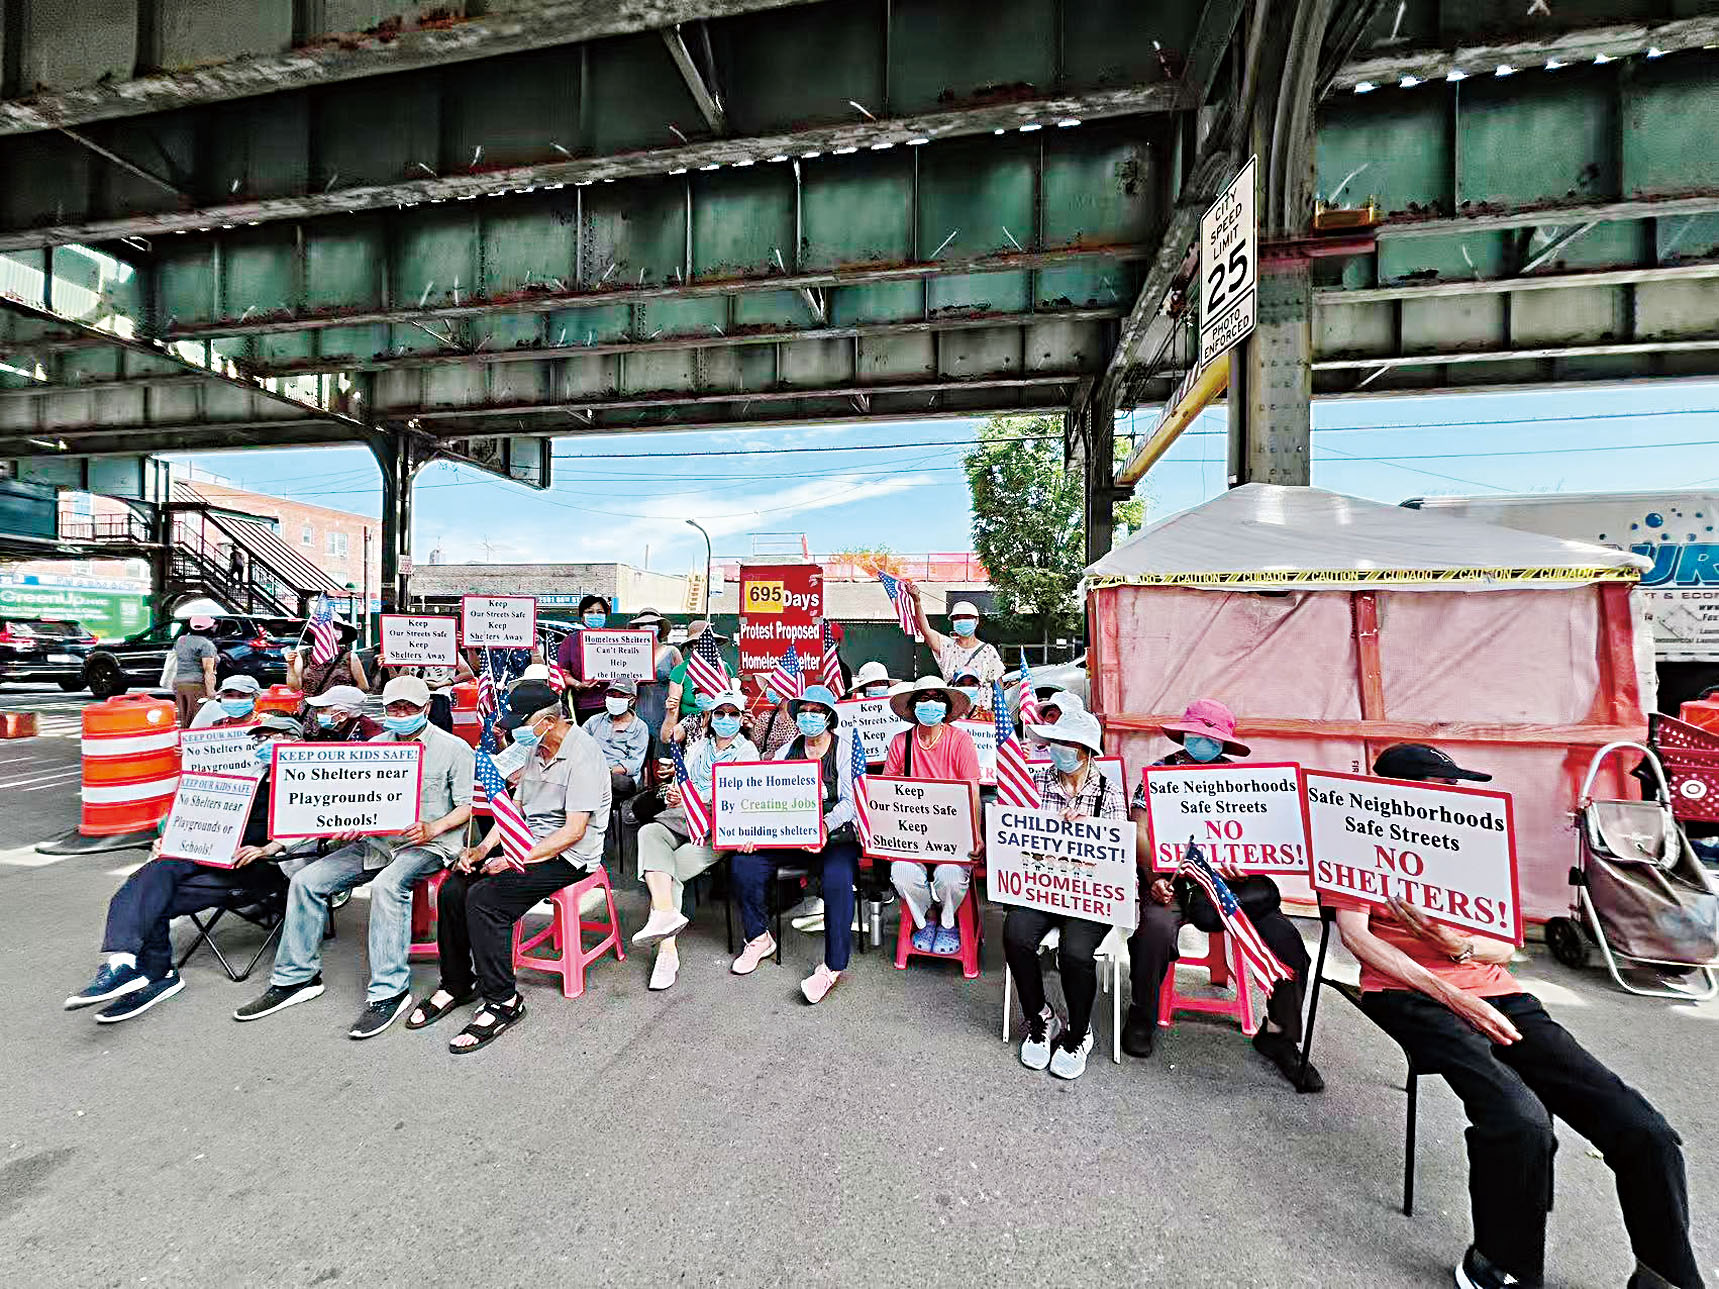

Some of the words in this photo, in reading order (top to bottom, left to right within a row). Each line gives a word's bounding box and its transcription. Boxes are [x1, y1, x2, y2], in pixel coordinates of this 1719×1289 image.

[1215, 188, 1237, 221] CITY
[1210, 203, 1242, 245] SPEED
[1213, 224, 1239, 261] LIMIT
[1207, 238, 1248, 314] 25
[1213, 309, 1240, 340] PHOTO
[1205, 315, 1249, 359] ENFORCED
[1178, 574, 1219, 583] CAUTION
[1312, 571, 1358, 580] CAUTION
[1384, 571, 1433, 580] CUIDADO
[488, 600, 508, 608] Keep
[750, 586, 781, 602] 695
[783, 590, 820, 611] Days
[408, 619, 428, 628] Keep
[488, 622, 507, 630] Keep
[585, 635, 619, 643] Homeless
[740, 622, 774, 639] Protest
[776, 621, 820, 644] Proposed
[409, 641, 429, 649] Keep
[618, 647, 640, 655] Really
[390, 651, 422, 660] Shelters
[426, 653, 446, 661] Away
[610, 659, 627, 667] Help
[861, 704, 882, 713] Keep
[859, 717, 887, 726] Streets
[182, 733, 204, 742] KEEP
[206, 732, 225, 740] OUR
[863, 731, 886, 741] Keep
[187, 747, 200, 756] No
[204, 744, 243, 755] Shelters
[278, 751, 314, 761] KEEP
[318, 751, 345, 760] OUR
[350, 751, 380, 760] KIDS
[383, 750, 418, 760] SAFE!
[191, 760, 251, 773] Playgrounds
[284, 769, 306, 781] No
[311, 768, 371, 780] Shelters
[377, 769, 408, 779] near
[199, 780, 214, 790] OUR
[215, 781, 231, 791] KIDS
[719, 777, 743, 790] Help
[746, 776, 763, 787] the
[766, 775, 816, 786] Homeless
[1149, 781, 1179, 794] Safe
[1184, 779, 1296, 796] Neighborhoods
[289, 791, 382, 806] Playgrounds
[387, 792, 402, 801] or
[894, 784, 924, 799] Keep
[178, 794, 189, 804] No
[191, 795, 221, 809] Shelters
[223, 802, 243, 811] near
[721, 800, 735, 813] By
[740, 798, 788, 810] Creating
[791, 797, 816, 809] Jobs
[869, 800, 890, 811] Our
[893, 802, 930, 815] Streets
[933, 805, 958, 816] Safe
[1181, 800, 1212, 813] Safe
[1216, 800, 1268, 813] Streets
[1308, 787, 1344, 806] Safe
[1349, 793, 1505, 832] Neighborhoods
[174, 816, 221, 832] Playgrounds
[223, 825, 233, 834] or
[316, 814, 377, 827] Schools!
[898, 820, 928, 835] Keep
[1001, 813, 1121, 843] CHILDREN'S
[719, 827, 736, 837] Not
[739, 826, 778, 838] building
[780, 826, 818, 836] shelters
[1204, 820, 1244, 840] NO
[1345, 816, 1384, 837] Safe
[1390, 824, 1460, 851] Streets
[180, 840, 213, 855] Schools!
[873, 835, 919, 850] Shelters
[925, 840, 958, 854] Away
[997, 831, 1063, 852] SAFETY
[1067, 841, 1125, 863] FIRST!
[1374, 844, 1424, 877] NO
[998, 869, 1022, 896] NO
[1024, 871, 1125, 901] HOMELESS
[1025, 888, 1112, 916] SHELTER!
[1317, 860, 1508, 929] SHELTERS!
